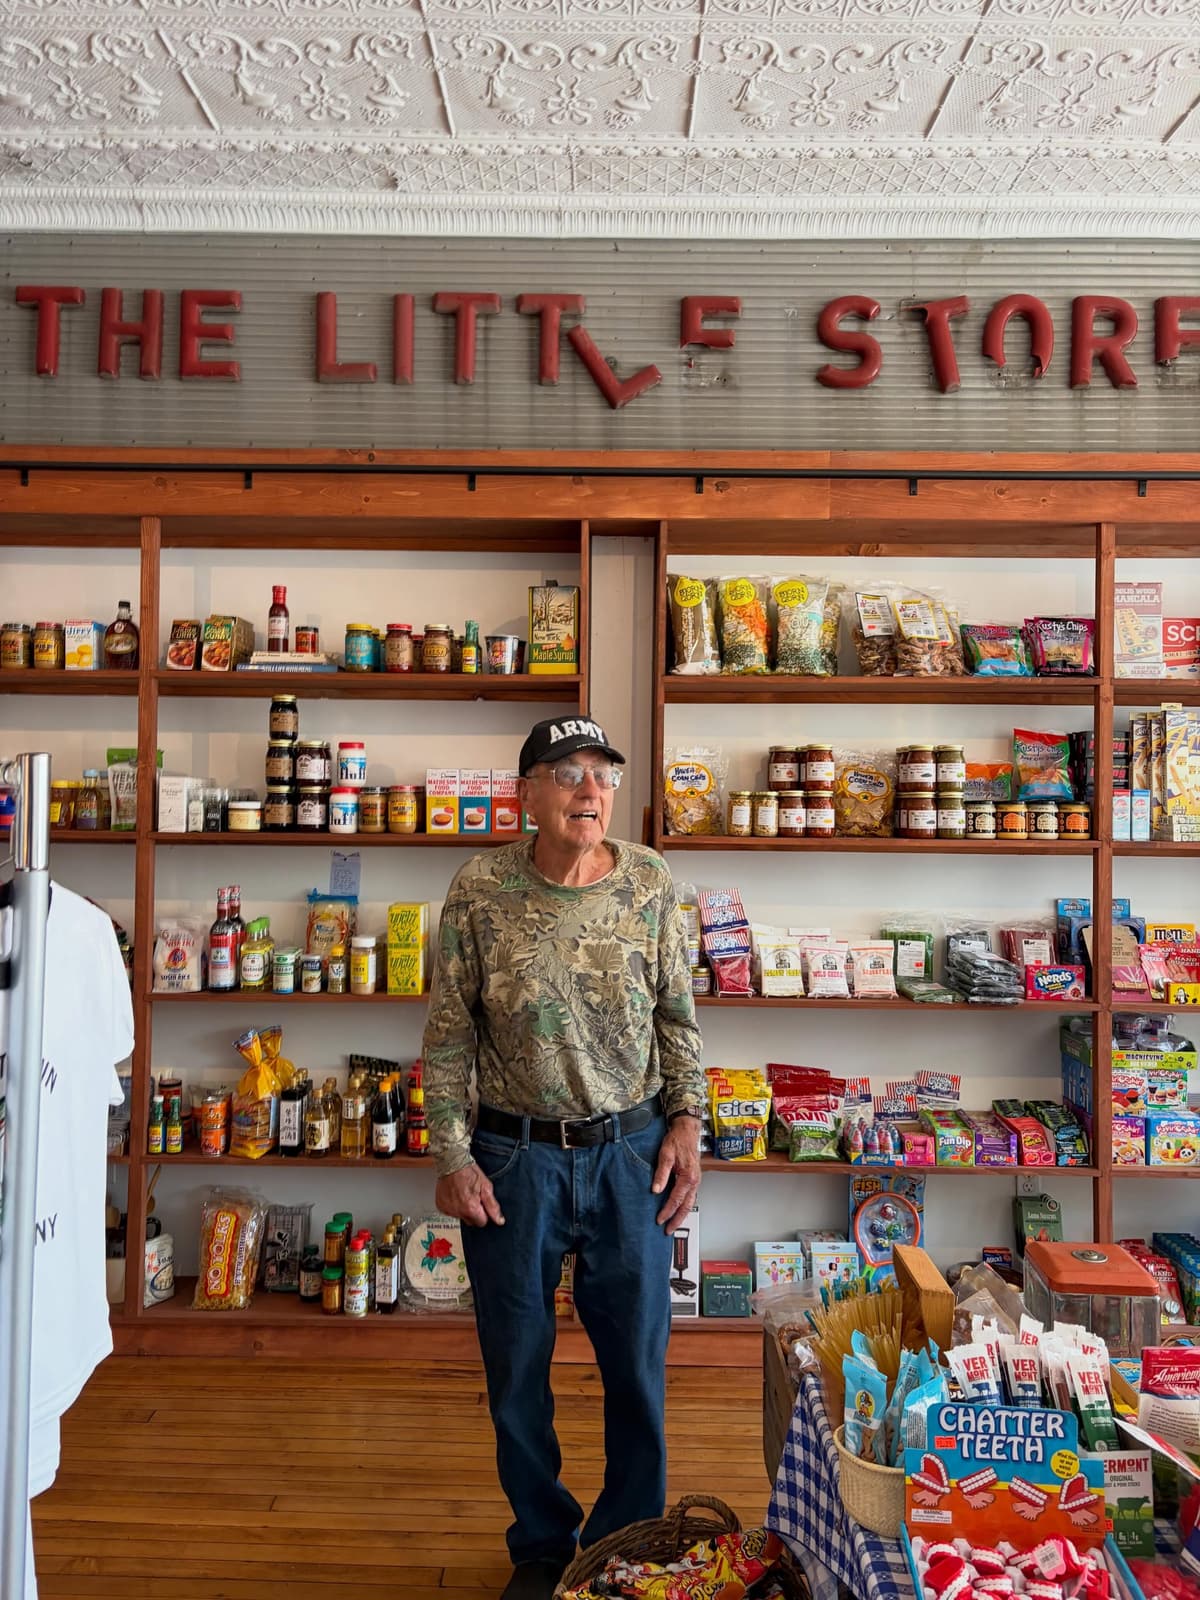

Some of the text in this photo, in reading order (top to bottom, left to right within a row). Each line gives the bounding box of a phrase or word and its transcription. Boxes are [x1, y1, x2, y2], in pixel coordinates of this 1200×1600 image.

[15, 286, 242, 382] THE
[67, 626, 92, 635] JIFFY
[1037, 620, 1088, 634] Rusty's Chips
[533, 648, 574, 661] Maple Syrup
[550, 719, 605, 744] ARMY
[113, 771, 136, 781] HEM
[718, 1099, 768, 1118] BiGS
[782, 1110, 828, 1124] DAVID
[940, 1136, 972, 1148] Fun Dip
[854, 1180, 881, 1191] FISH
[854, 1190, 874, 1198] Gam
[208, 1215, 231, 1290] NO YOLKS
[1020, 1329, 1039, 1346] VER
[1082, 1344, 1101, 1358] VE
[963, 1356, 988, 1371] VER
[1012, 1359, 1037, 1371] VER
[966, 1370, 990, 1382] MONT
[1014, 1371, 1039, 1382] MONT
[1077, 1371, 1102, 1385] VER
[1082, 1384, 1104, 1396] MONT
[938, 1405, 1065, 1438] CHATTER
[956, 1433, 1044, 1463] TEETH
[1104, 1458, 1150, 1473] ERMONT
[1109, 1474, 1134, 1482] ORIGINAL
